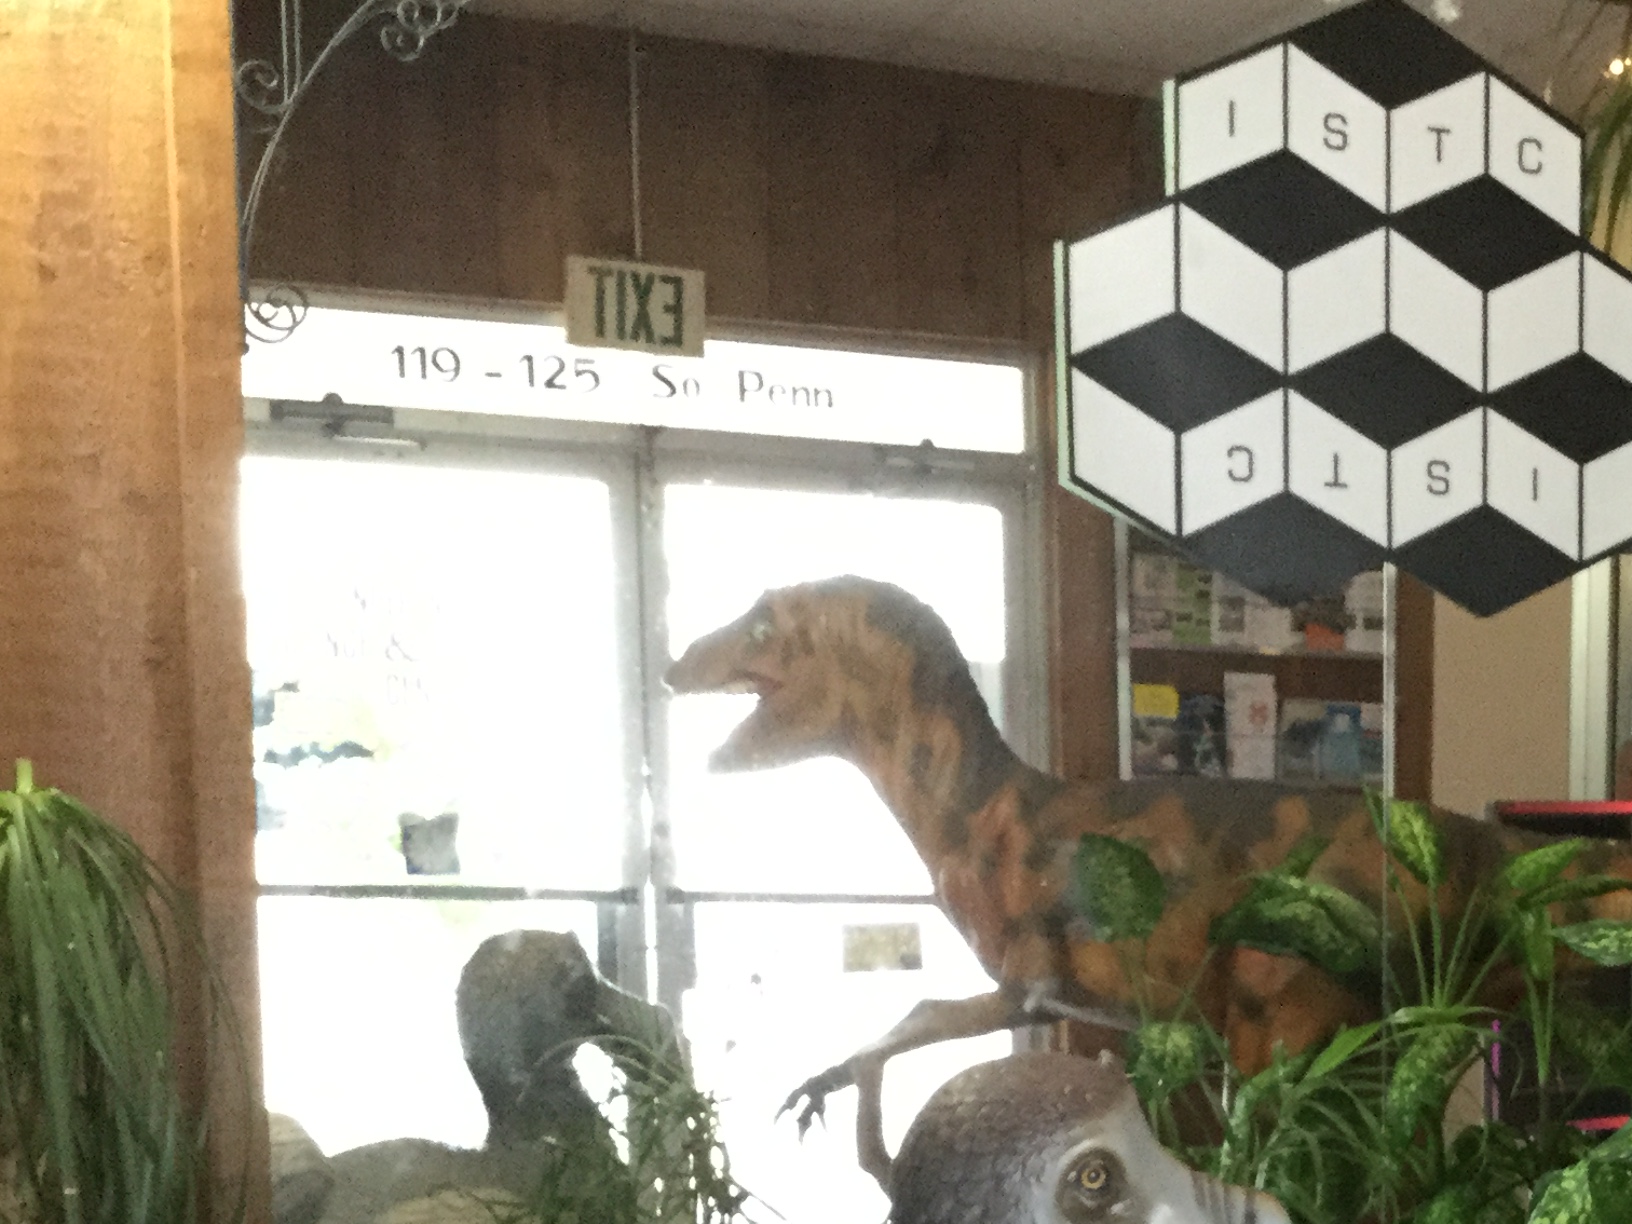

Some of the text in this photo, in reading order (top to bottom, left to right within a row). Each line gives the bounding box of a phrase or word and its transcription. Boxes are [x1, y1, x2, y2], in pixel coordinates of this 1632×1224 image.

[1226, 99, 1544, 177] ISTC
[391, 345, 461, 382] 119
[519, 354, 600, 393] 125
[738, 370, 833, 408] Penn
